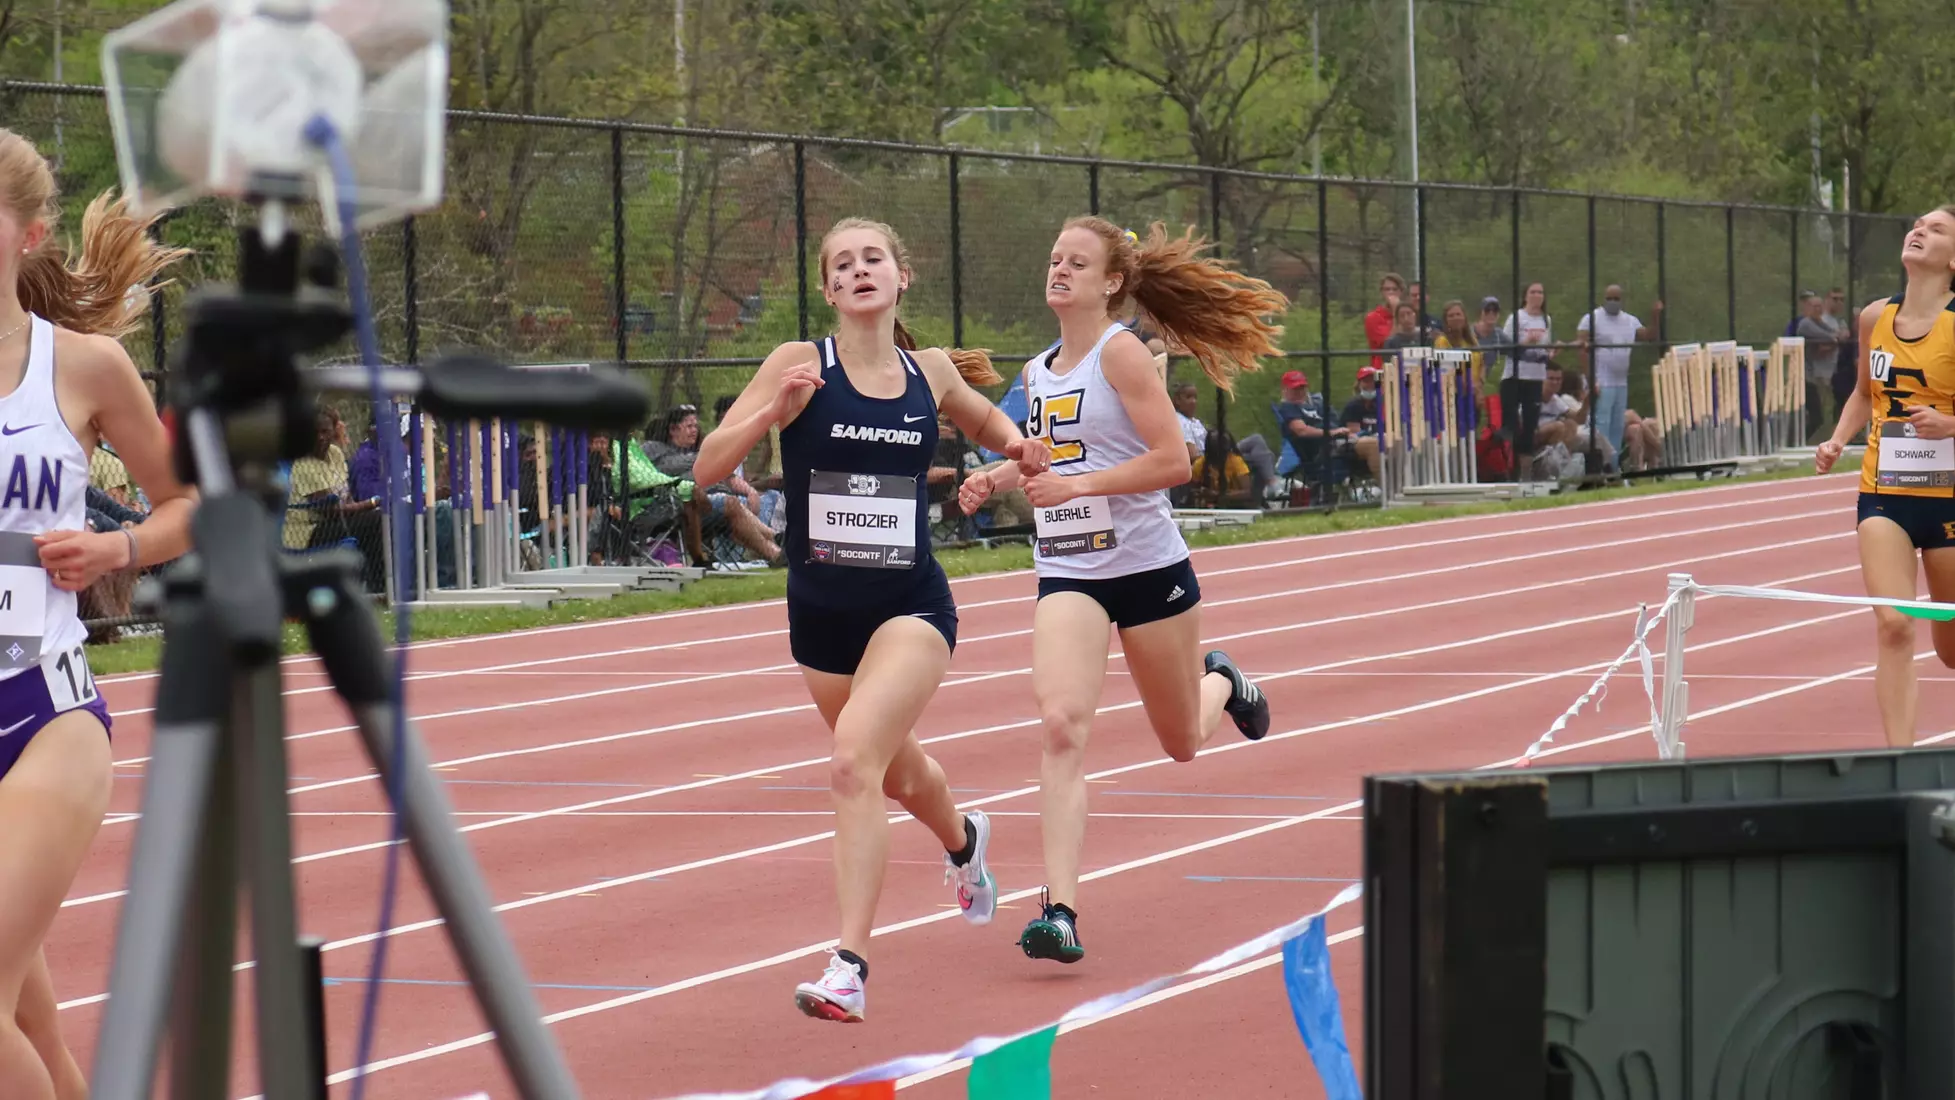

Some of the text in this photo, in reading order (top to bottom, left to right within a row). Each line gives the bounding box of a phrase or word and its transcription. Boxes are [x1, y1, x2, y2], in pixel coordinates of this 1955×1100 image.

[1871, 352, 1887, 379] 10
[830, 423, 923, 446] SAMFORD
[1894, 449, 1936, 460] SCHWARZ
[826, 511, 899, 530] STROZIER
[1044, 506, 1092, 524] BUERHLE
[1054, 539, 1086, 550] #SOCONTF
[837, 549, 881, 560] #SOCONTF
[56, 646, 94, 703] 12
